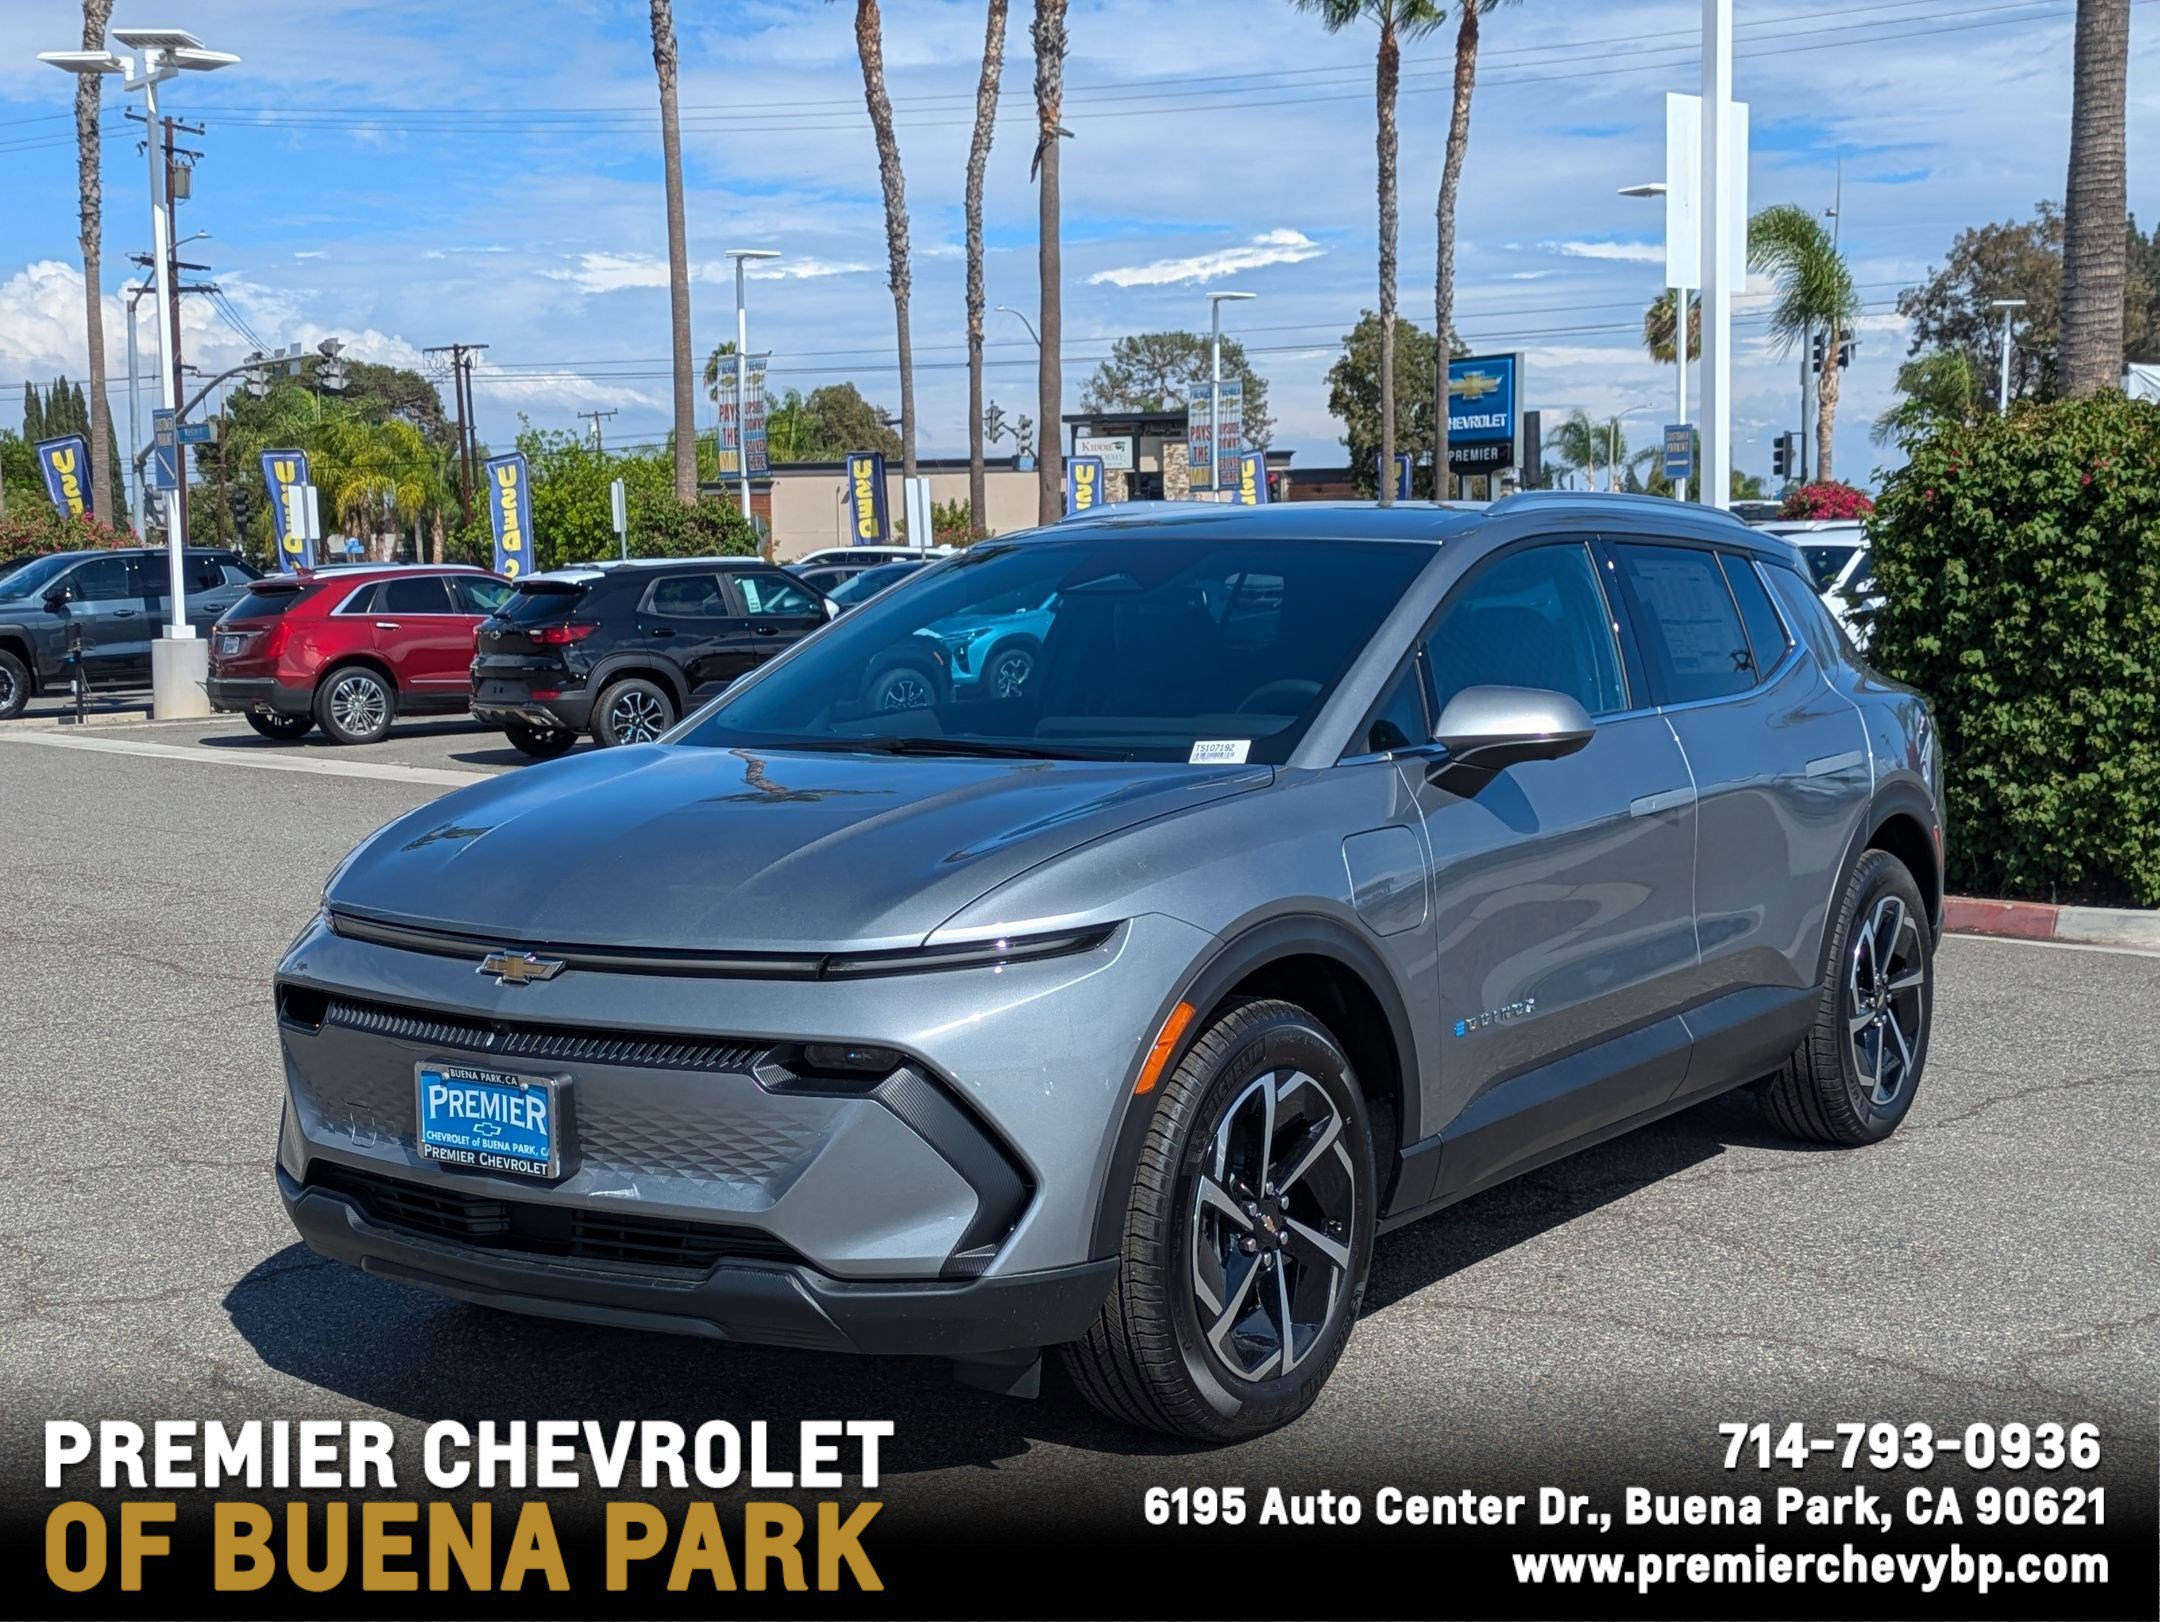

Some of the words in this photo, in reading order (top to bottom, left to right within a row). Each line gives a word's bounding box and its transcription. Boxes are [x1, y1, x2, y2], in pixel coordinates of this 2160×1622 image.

[719, 404, 739, 422] PAYS
[1449, 414, 1507, 431] HEVROLET
[723, 427, 738, 446] THE
[1190, 425, 1212, 441] PAYS
[1193, 446, 1208, 463] THE
[1449, 447, 1498, 462] PREMIER
[1196, 743, 1236, 752] TS107192
[450, 1068, 479, 1081] BUENA
[428, 1084, 548, 1136] PREMIER
[426, 1130, 470, 1146] CHEVROLET
[471, 1137, 481, 1147] of
[482, 1139, 510, 1152] BUENA
[512, 1143, 539, 1157] PARK,
[424, 1143, 476, 1165] PREMIER
[479, 1151, 548, 1176] CHEVROLET
